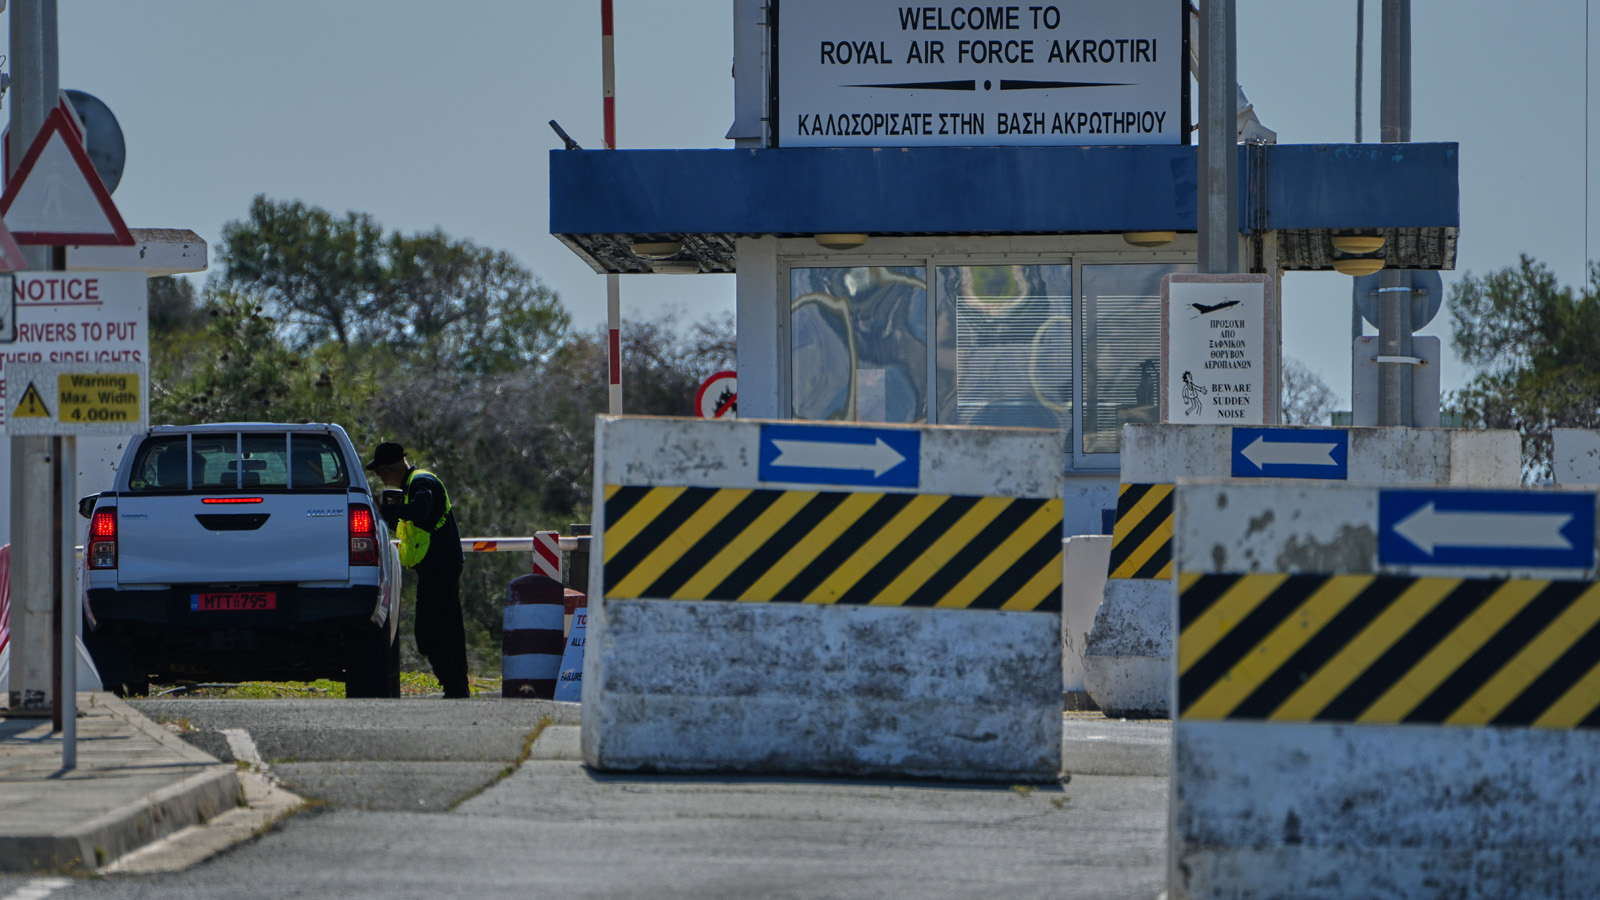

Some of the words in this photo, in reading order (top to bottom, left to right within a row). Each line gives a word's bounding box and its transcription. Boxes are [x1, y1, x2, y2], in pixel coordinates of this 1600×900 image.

[898, 6, 1020, 31] WELCOME
[1028, 5, 1061, 30] TO
[820, 40, 893, 65] ROYAL
[906, 40, 945, 64] AIR
[958, 39, 1034, 64] FORCE
[1047, 38, 1157, 63] AKROTIRI
[798, 113, 933, 136] ΚΑΛΩΣΟΡΙΣΑΤΕ
[938, 112, 985, 135] ΣΤΗΝ
[998, 112, 1045, 135] ΒΑΣΗ
[1051, 111, 1167, 135] ΑΚΡΩΤΗΡΙΟΥ
[15, 278, 99, 301] NOTICE
[1210, 320, 1245, 329] ΠΡΟΣΟΧΗ
[81, 322, 102, 342] TO
[106, 322, 137, 341] PUT
[1220, 330, 1235, 338] ΑΠΟ
[1209, 340, 1246, 349] ΞΑΦΝΙΚΟΝ
[1210, 350, 1245, 359] ΘΟΡΥΒΟΝ
[1204, 360, 1252, 370] ΑΕΡΟΠΛΑΝΩΝ
[71, 374, 127, 390] Warning
[1211, 383, 1252, 393] BEWARE
[60, 391, 91, 404] Max.
[98, 391, 136, 404] Width
[1213, 396, 1250, 406] SUDDEN
[71, 408, 127, 421] 4.00m
[1217, 409, 1246, 419] NOISE
[306, 509, 344, 518] HILUX
[204, 594, 233, 609] MTT
[240, 593, 268, 608] 795
